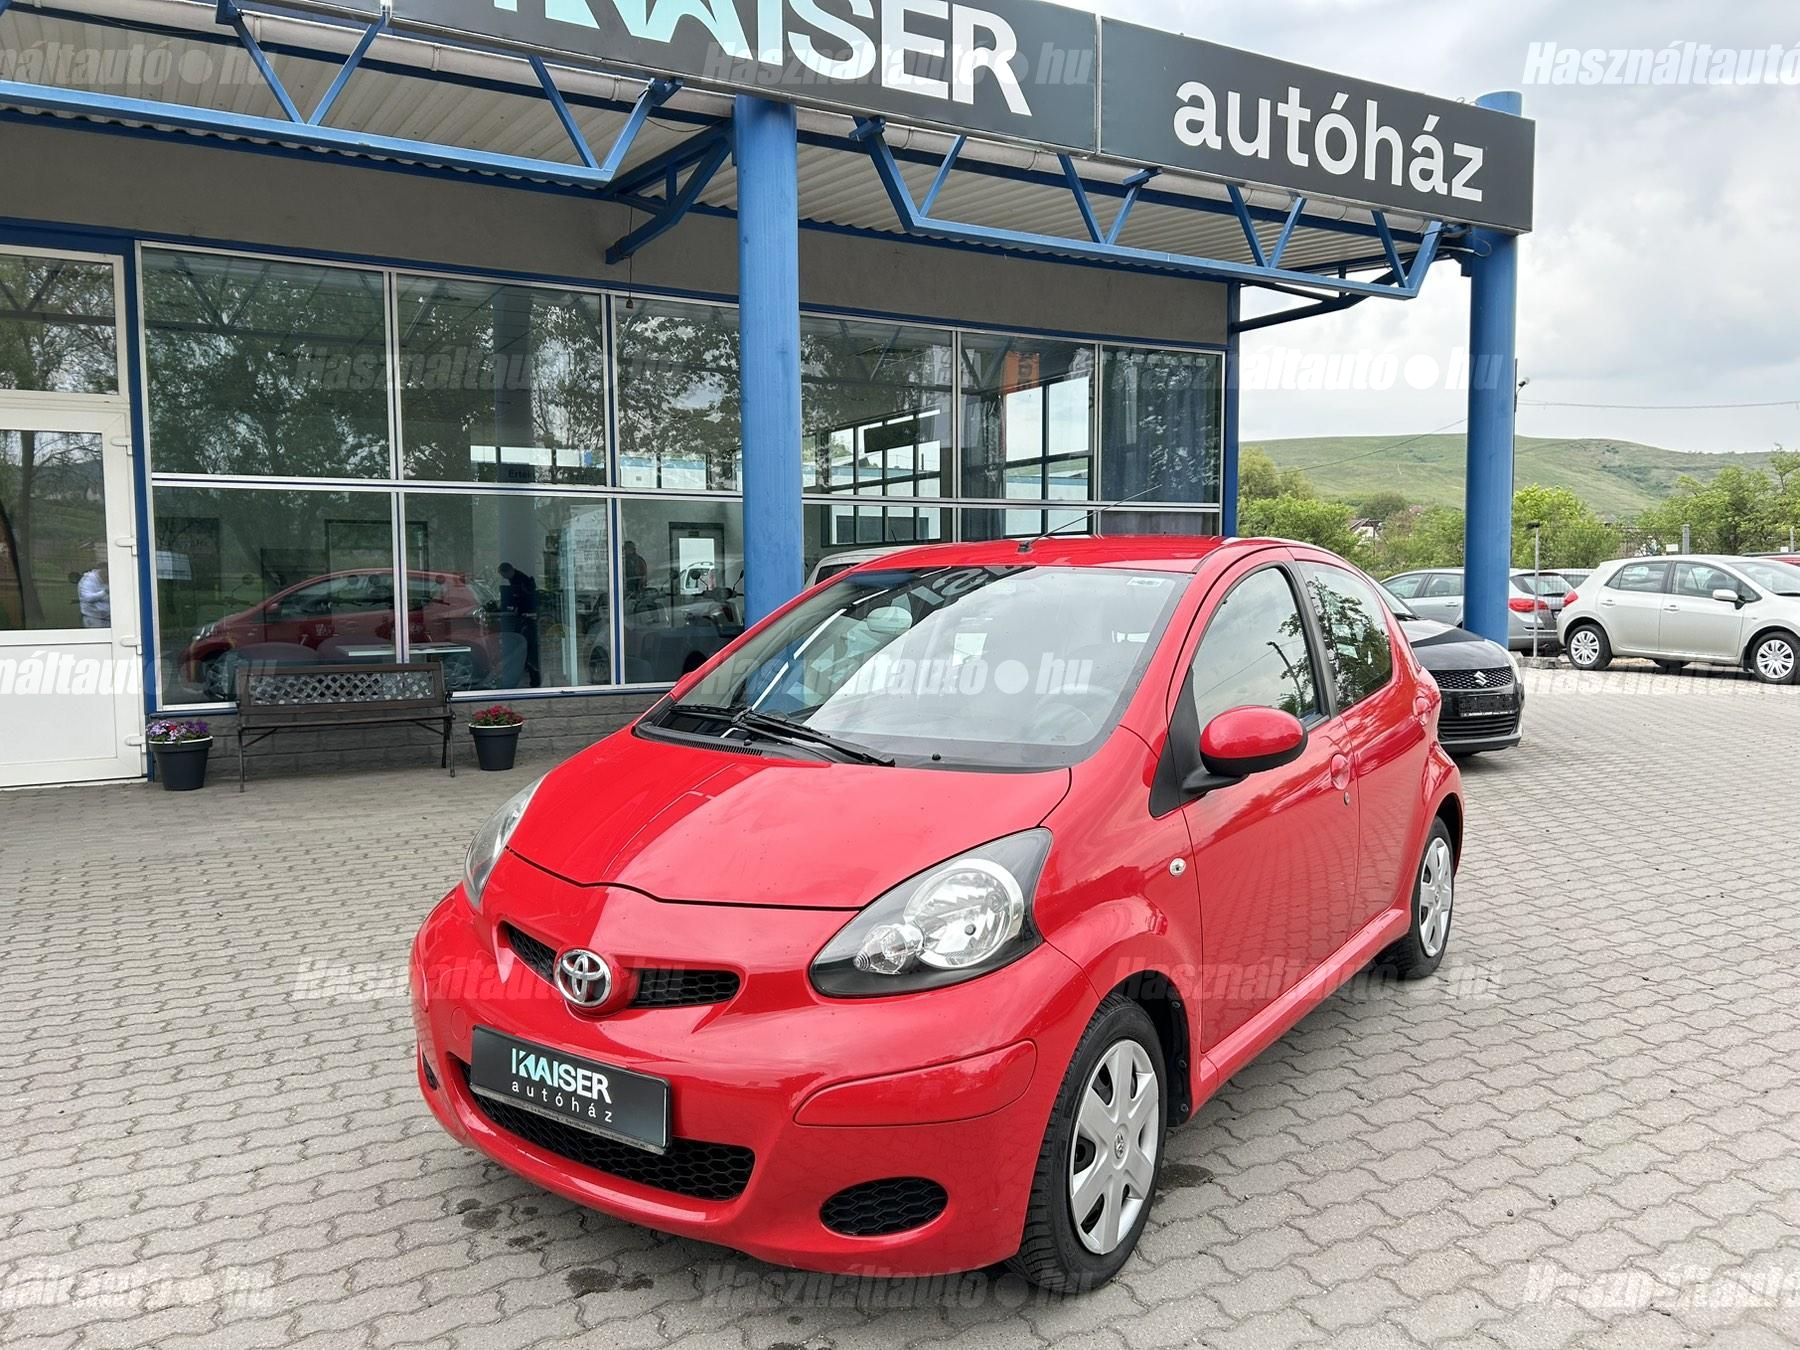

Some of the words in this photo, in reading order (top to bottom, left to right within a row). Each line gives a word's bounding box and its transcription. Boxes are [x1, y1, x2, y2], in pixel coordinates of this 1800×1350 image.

[494, 0, 1032, 116] AISER
[1173, 80, 1486, 202] autóház
[511, 1047, 612, 1104] KAISER
[511, 1081, 613, 1123] autóház
